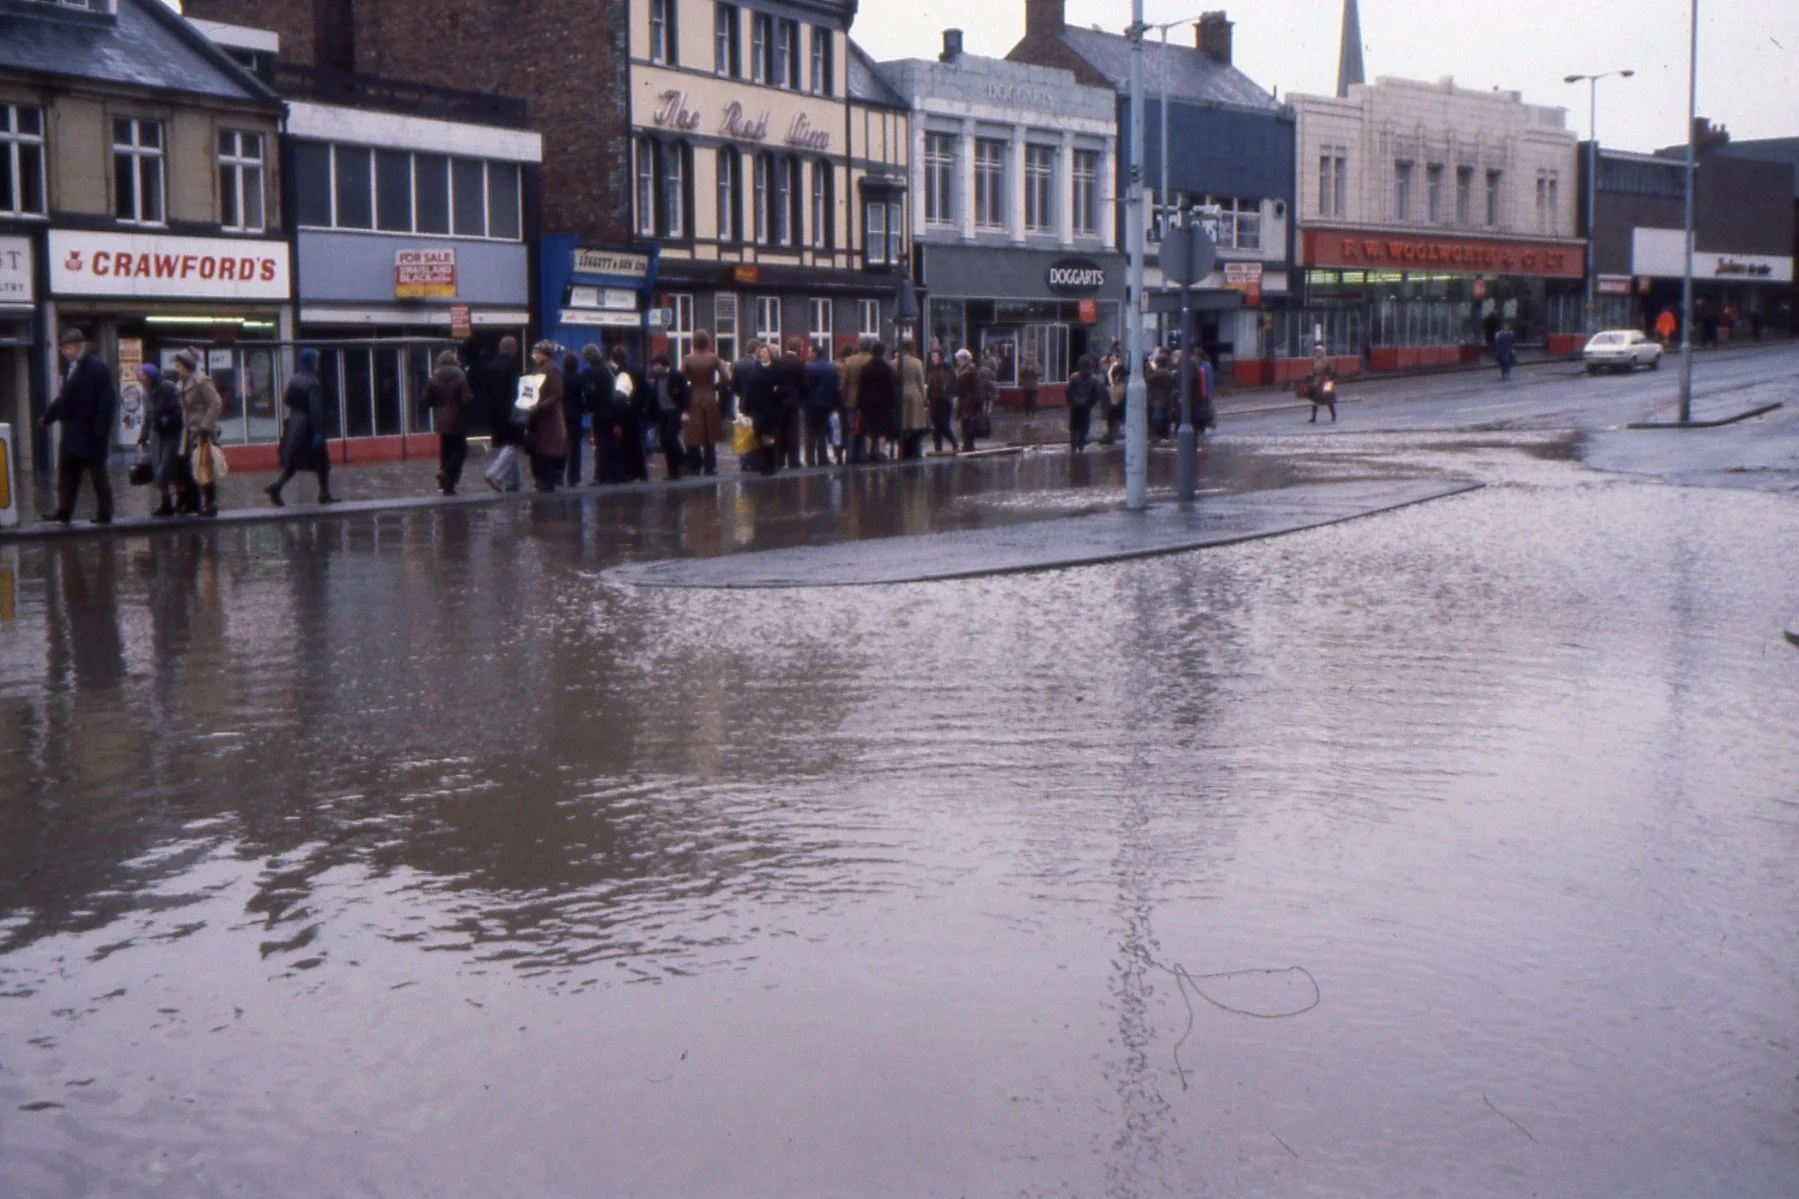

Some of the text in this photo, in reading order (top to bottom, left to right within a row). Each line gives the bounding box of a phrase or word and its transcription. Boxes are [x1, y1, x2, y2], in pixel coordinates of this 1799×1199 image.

[655, 89, 830, 150] The Red Lion
[399, 252, 451, 263] FOR SALE
[1388, 240, 1496, 264] WOOLWORTH
[91, 250, 276, 282] CRAWFORD'S
[1049, 267, 1105, 285] DOGGARTS
